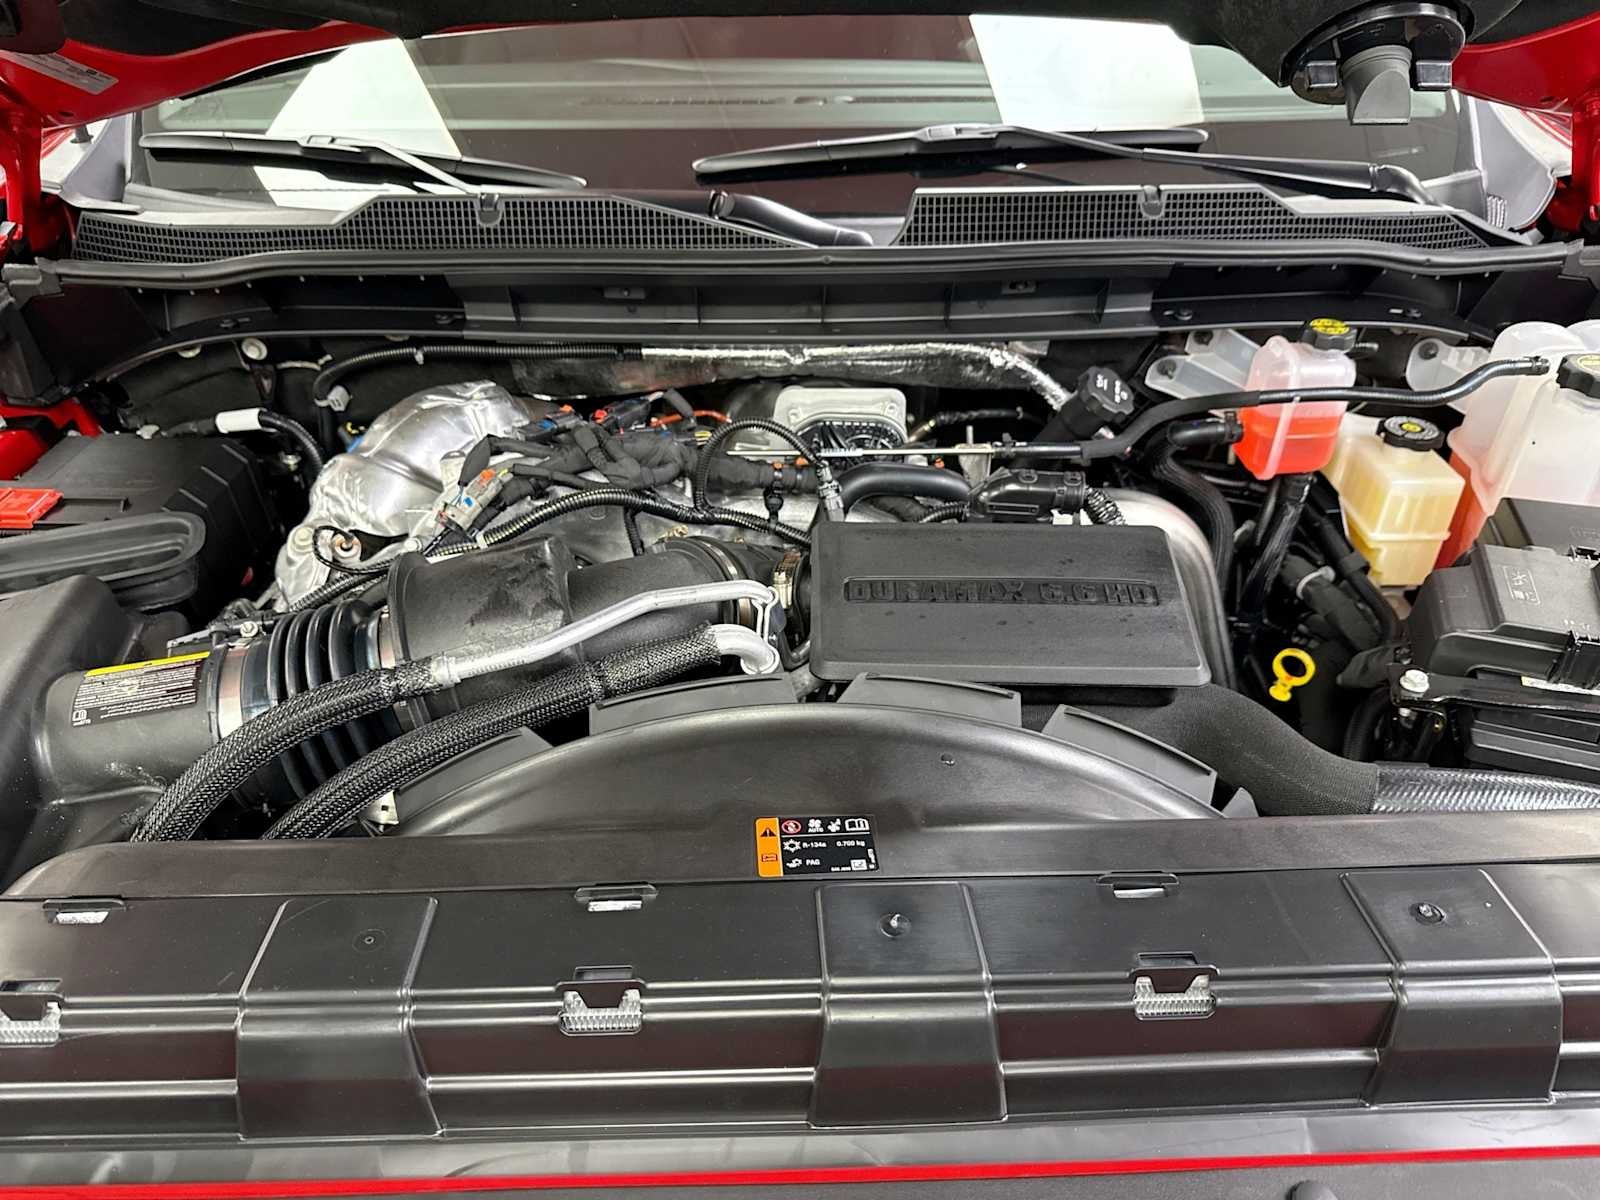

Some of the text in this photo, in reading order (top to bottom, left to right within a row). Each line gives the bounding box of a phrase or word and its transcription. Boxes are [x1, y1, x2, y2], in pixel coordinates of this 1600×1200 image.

[846, 580, 1160, 605] DURAMAX 6.6 HD
